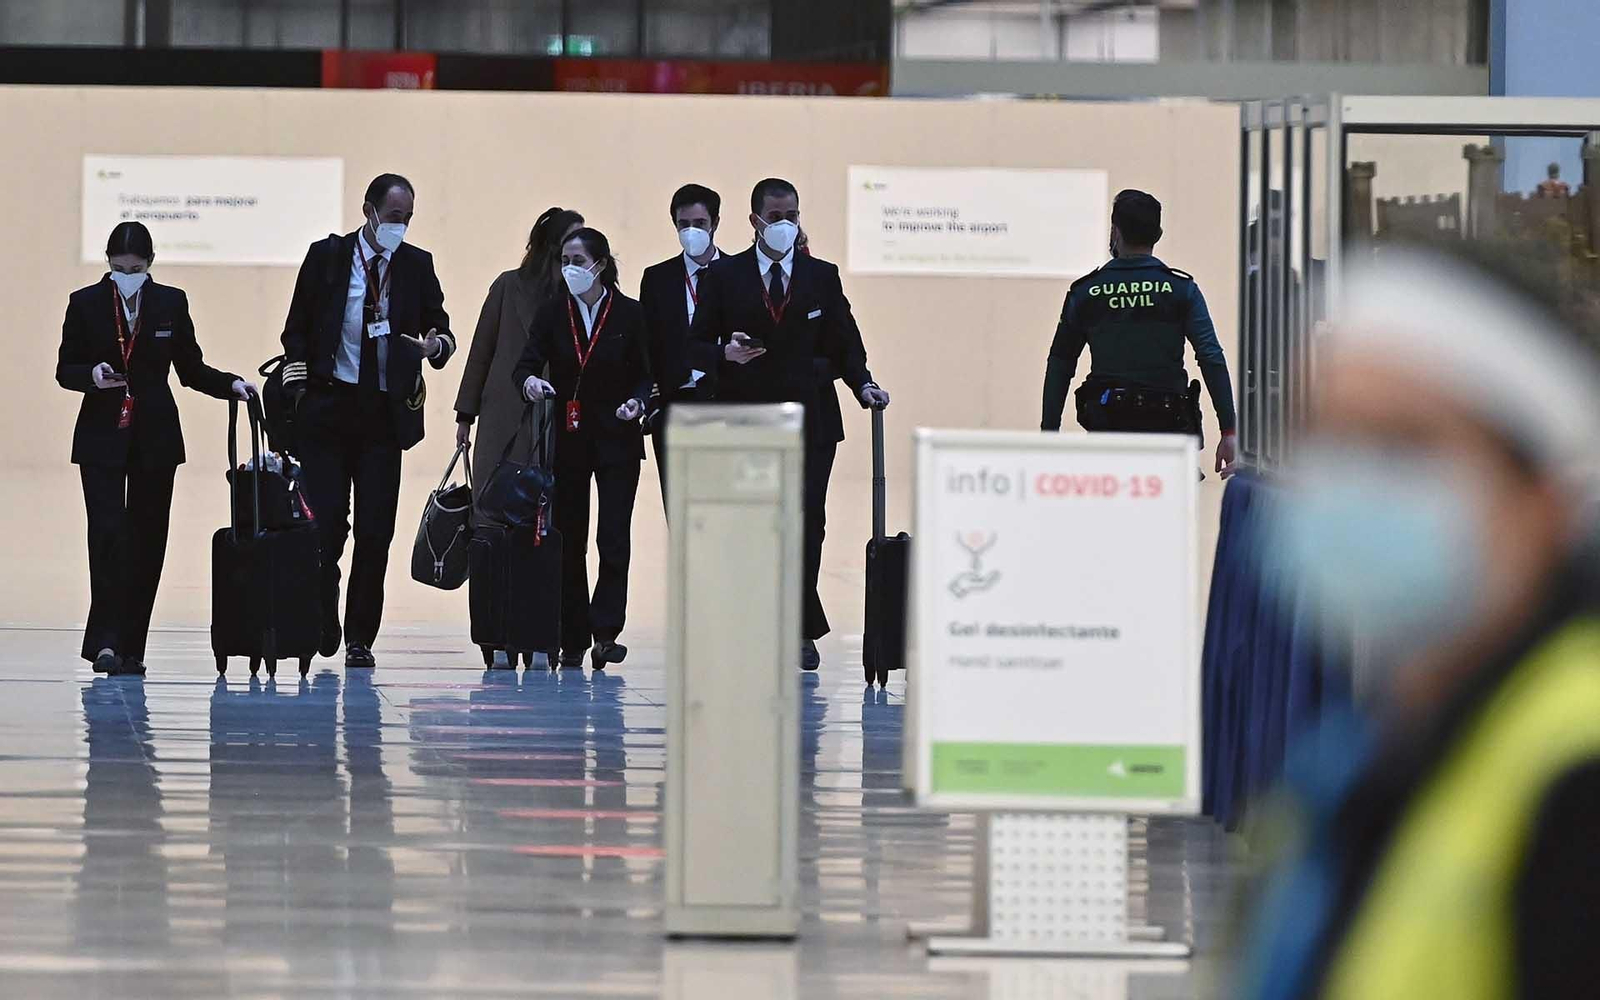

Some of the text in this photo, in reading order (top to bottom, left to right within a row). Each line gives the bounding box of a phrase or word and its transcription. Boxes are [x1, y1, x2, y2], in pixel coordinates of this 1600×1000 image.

[917, 206, 960, 219] working
[899, 221, 943, 234] improve
[947, 221, 966, 232] the
[970, 222, 1008, 236] airport
[1088, 280, 1173, 297] GUARDIA
[1108, 294, 1154, 310] CIVIL
[946, 466, 1164, 499] info COVID-19
[948, 620, 1120, 640] Gel desinfectante
